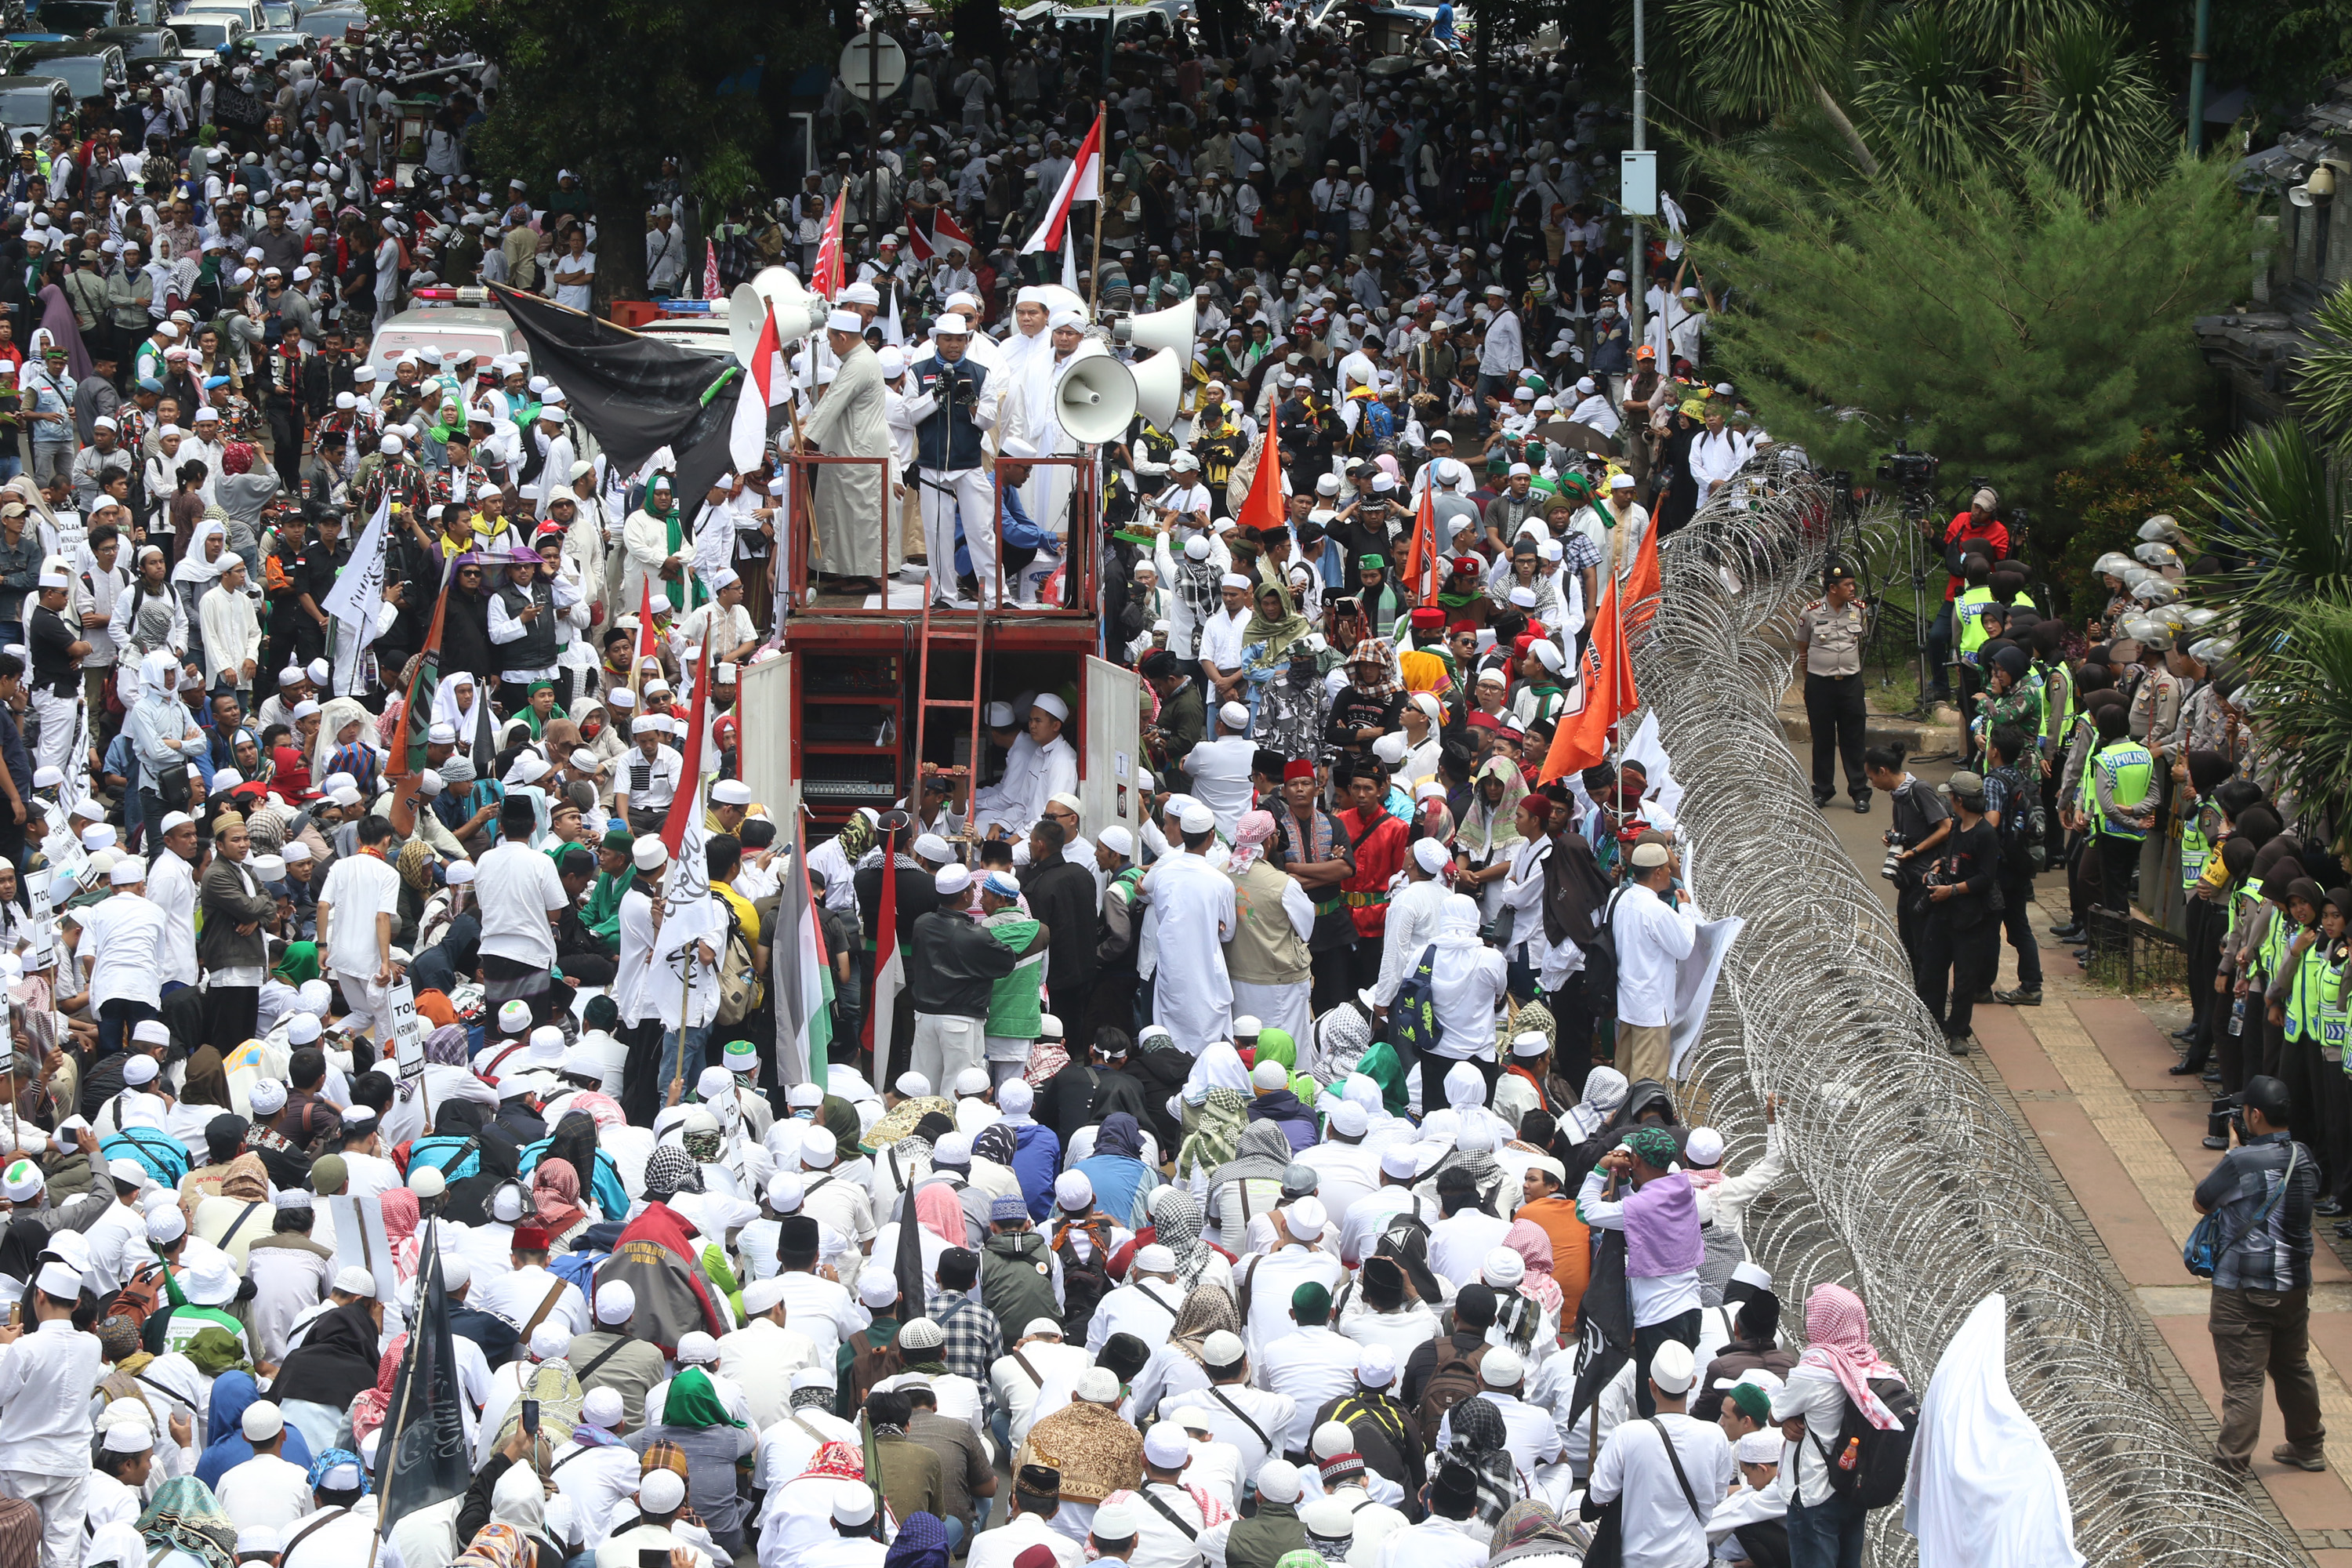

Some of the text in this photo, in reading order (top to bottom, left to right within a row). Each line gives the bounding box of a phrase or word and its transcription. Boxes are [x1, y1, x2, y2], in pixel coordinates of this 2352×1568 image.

[450, 230, 464, 248] FPI
[1119, 755, 1123, 775] 1
[34, 887, 51, 904] TOL
[394, 1000, 416, 1017] TOL
[624, 1243, 667, 1260] SILIWANGI
[630, 1254, 657, 1265] SQUAD
